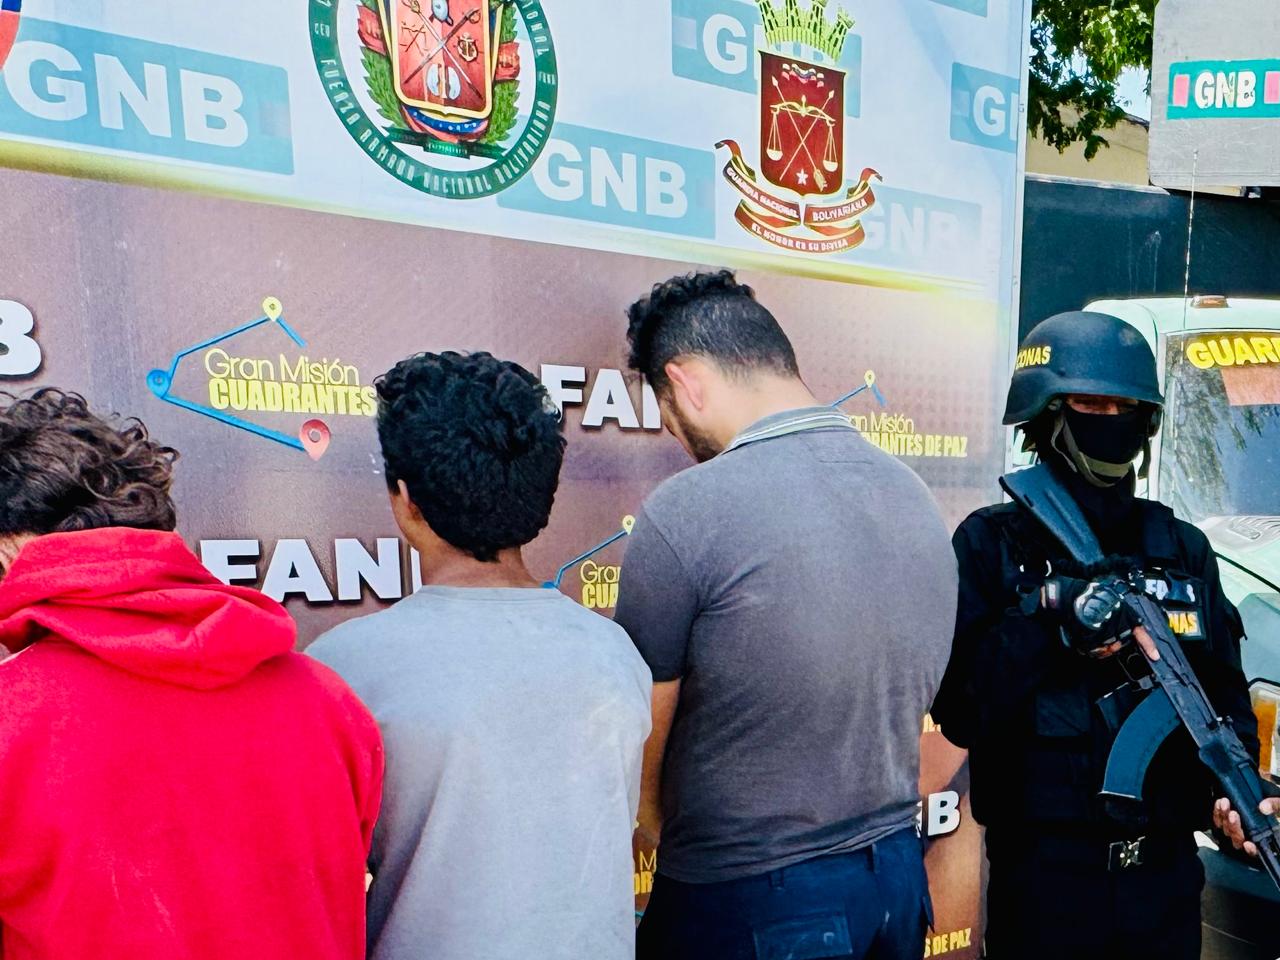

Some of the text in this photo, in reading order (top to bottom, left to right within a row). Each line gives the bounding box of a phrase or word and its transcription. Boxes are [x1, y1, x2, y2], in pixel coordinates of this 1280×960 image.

[4, 40, 249, 149] GNB
[1194, 70, 1257, 109] GNB
[531, 138, 689, 219] GNB
[205, 349, 359, 386] Gran Misión
[208, 377, 377, 417] CUADRANTES
[870, 410, 915, 434] Misión
[942, 435, 968, 458] PAZ
[200, 538, 422, 602] FAN
